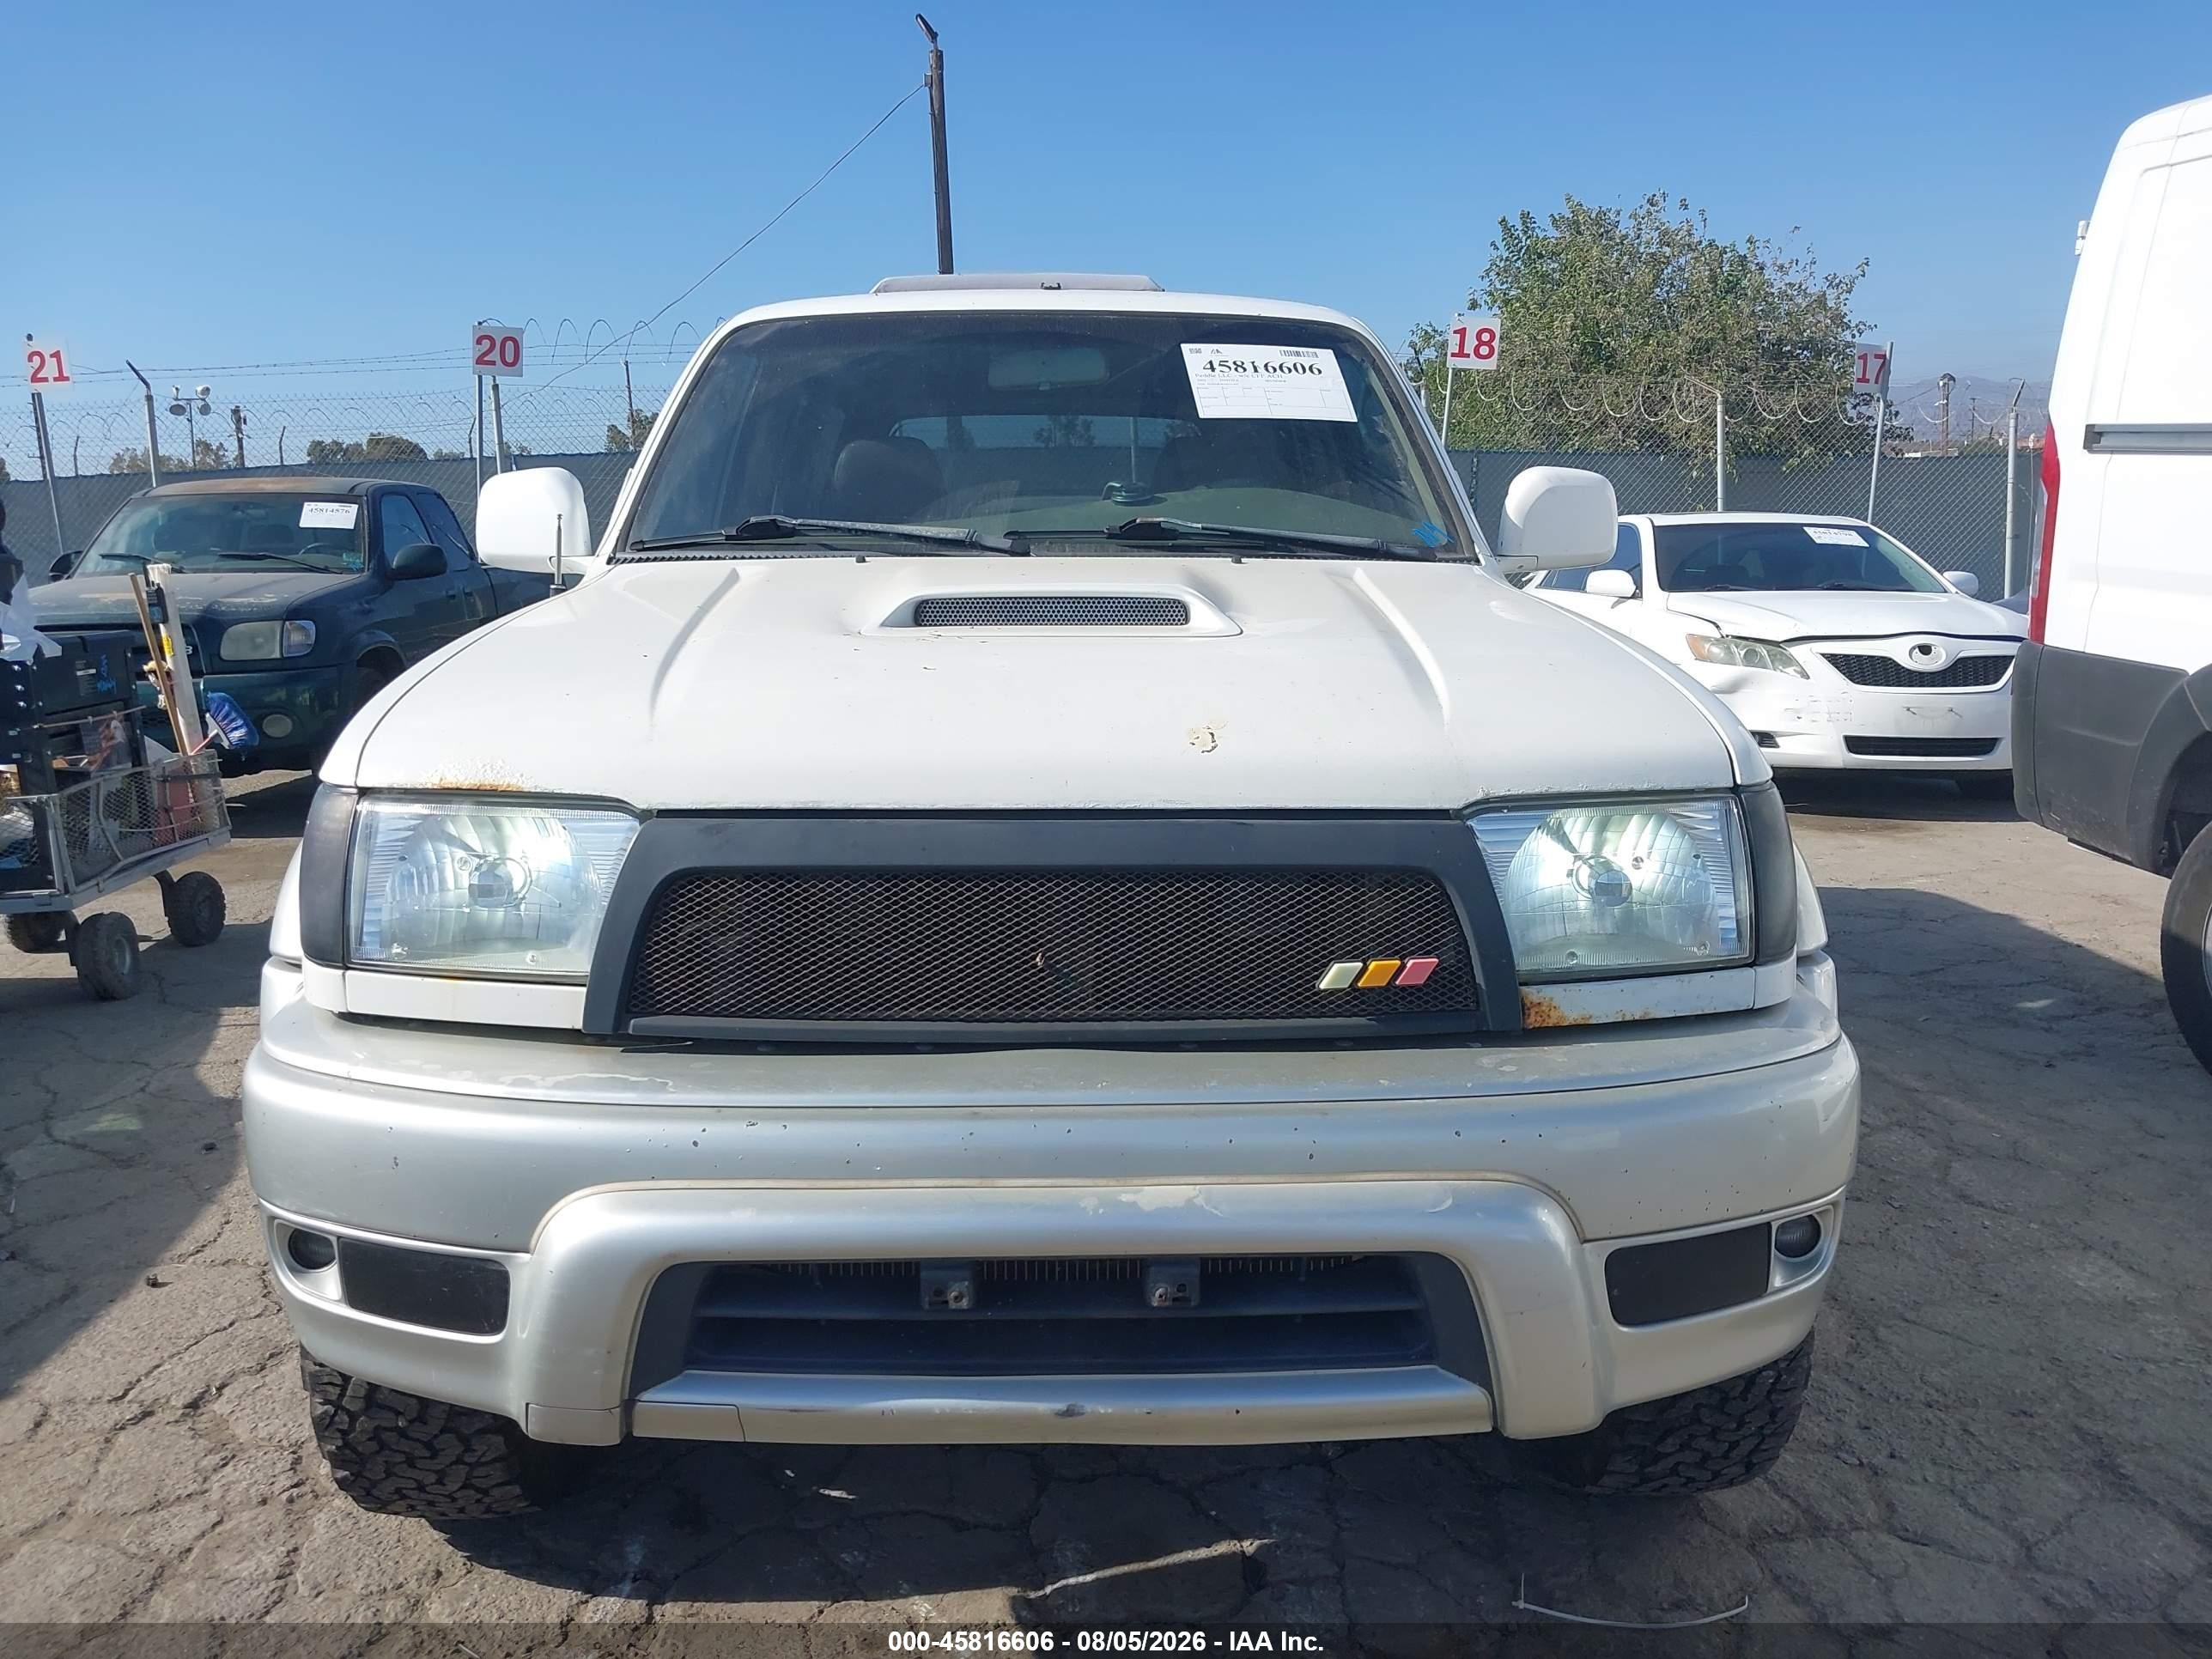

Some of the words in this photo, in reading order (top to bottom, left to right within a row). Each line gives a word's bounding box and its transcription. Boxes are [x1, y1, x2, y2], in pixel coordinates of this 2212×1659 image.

[476, 335, 520, 368] 20
[1450, 327, 1496, 360] 18
[27, 350, 70, 384] 21
[1203, 359, 1323, 376] 45816606
[1856, 352, 1887, 385] 17
